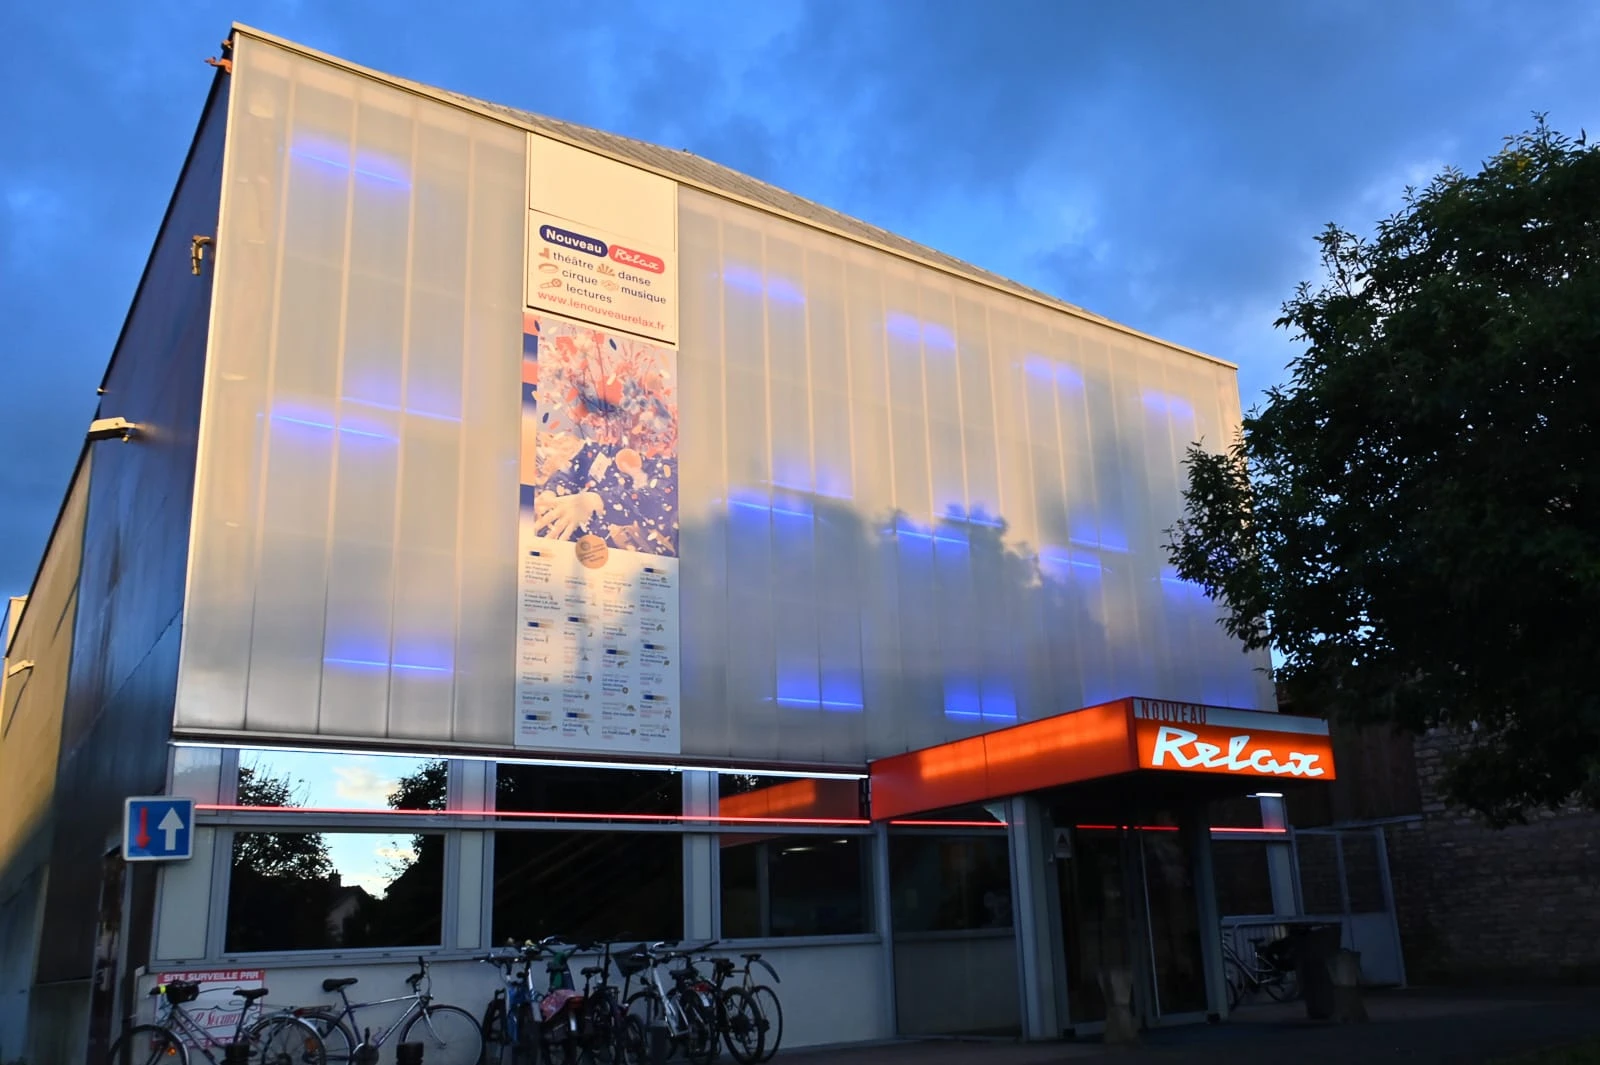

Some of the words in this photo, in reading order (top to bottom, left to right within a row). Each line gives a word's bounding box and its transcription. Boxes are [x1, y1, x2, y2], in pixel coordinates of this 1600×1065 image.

[546, 228, 602, 254] Nouveau
[614, 248, 660, 270] Relax
[553, 251, 594, 271] théâtre
[618, 271, 651, 287] danse
[562, 269, 598, 286] cirque
[621, 285, 667, 305] musique
[537, 291, 665, 331] www.lenouveaurelax.fr
[566, 283, 613, 304] lectures
[1141, 700, 1207, 725] NOUVEAU
[1152, 726, 1325, 777] Relax
[163, 973, 186, 982] SITE
[240, 970, 259, 980] PAR
